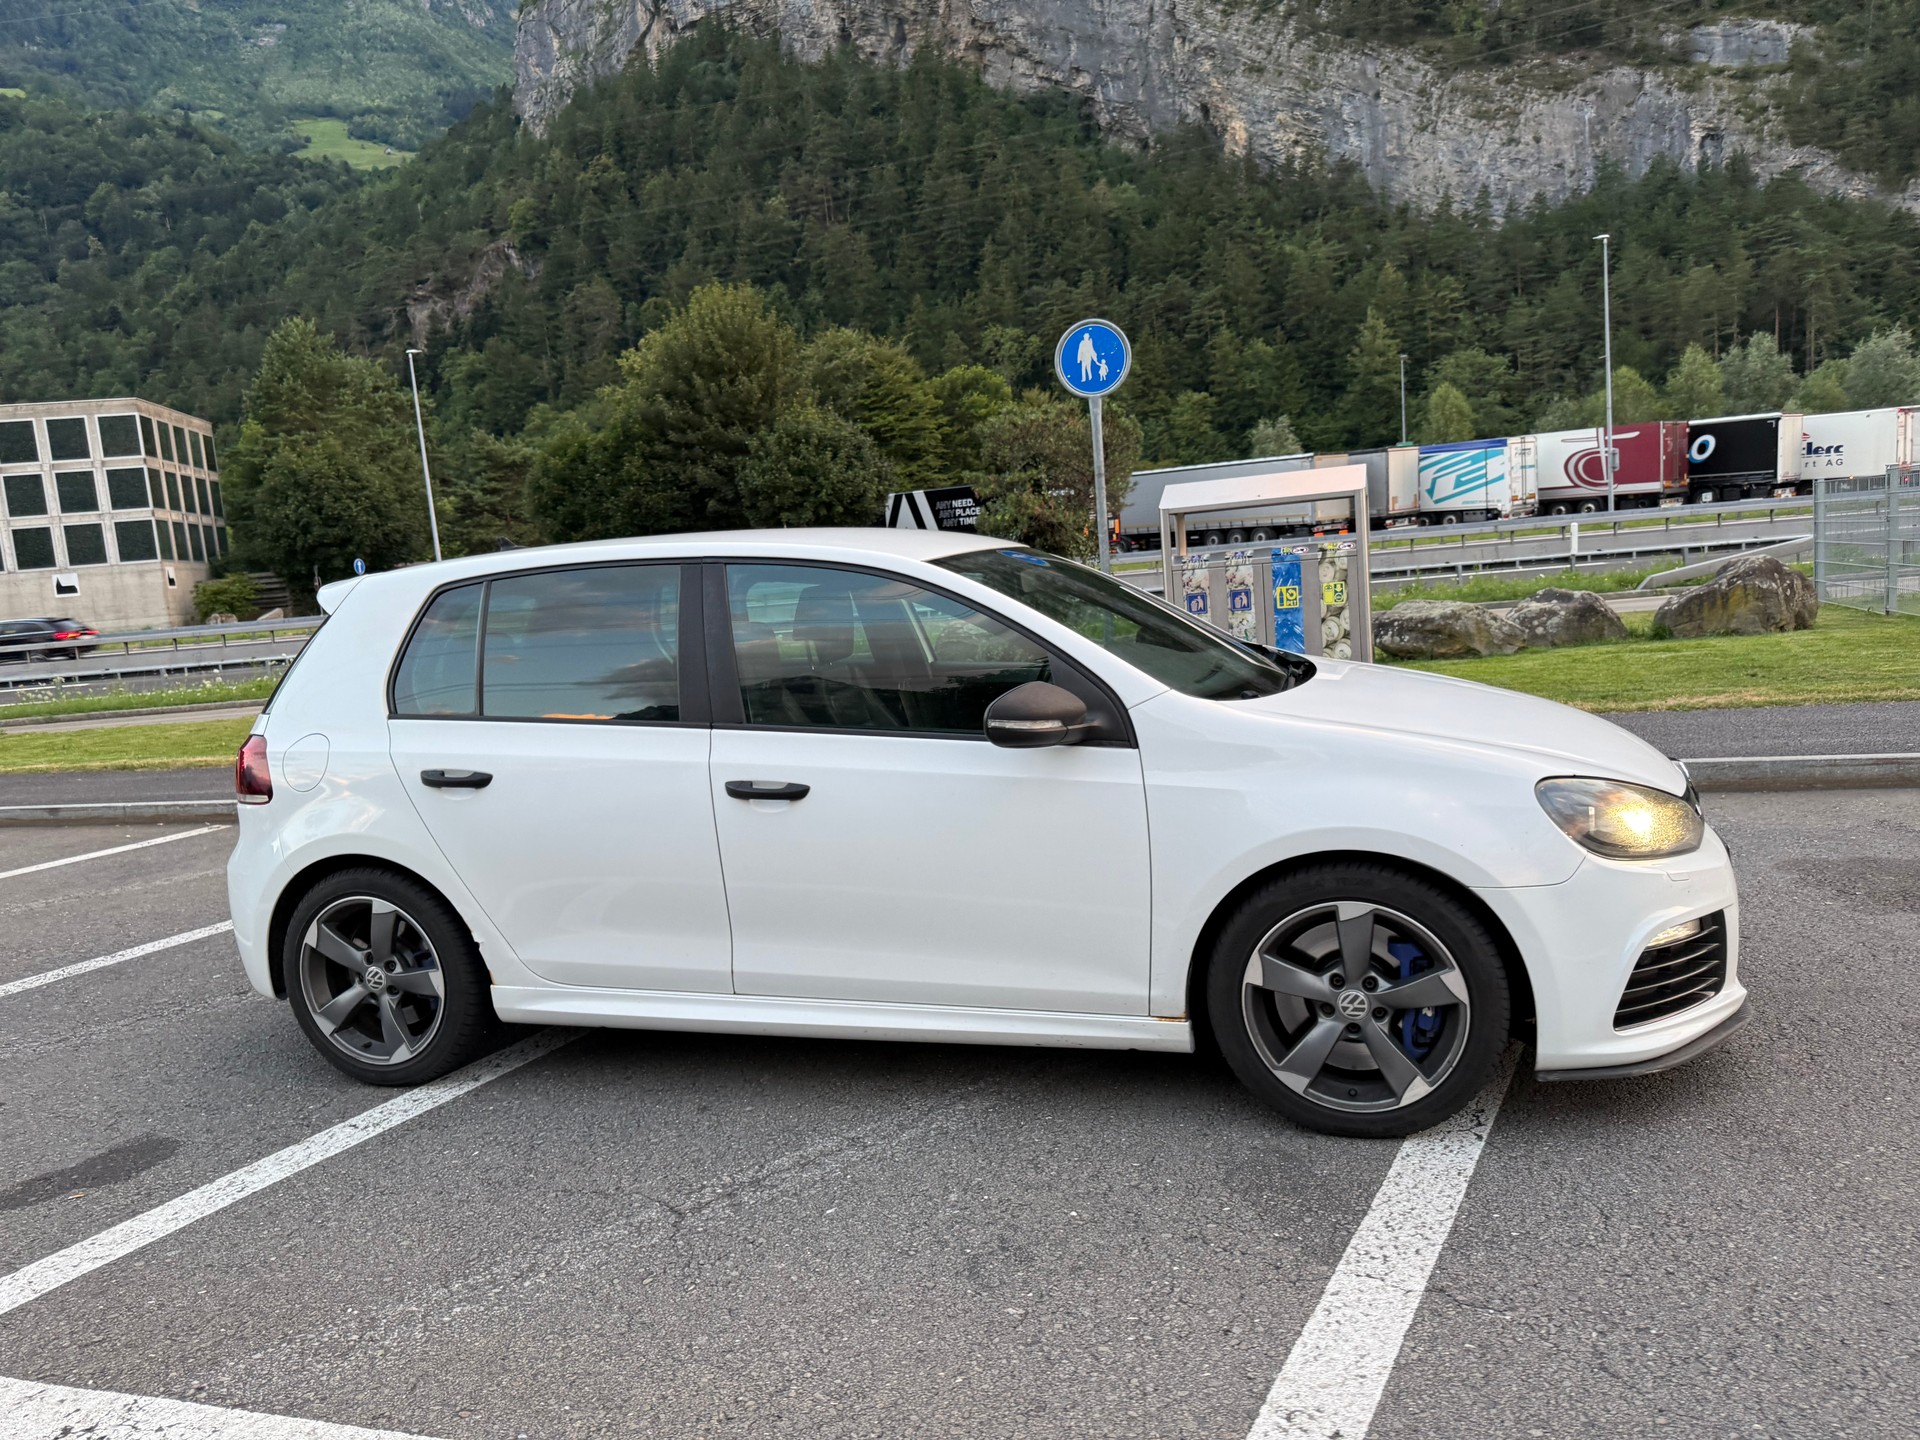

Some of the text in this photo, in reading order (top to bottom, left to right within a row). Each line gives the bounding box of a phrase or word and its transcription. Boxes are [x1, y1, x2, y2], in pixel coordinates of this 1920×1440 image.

[1825, 458, 1844, 467] AG
[935, 498, 975, 510] ANY NEED.
[939, 509, 955, 519] ANY
[942, 518, 958, 528] ANY
